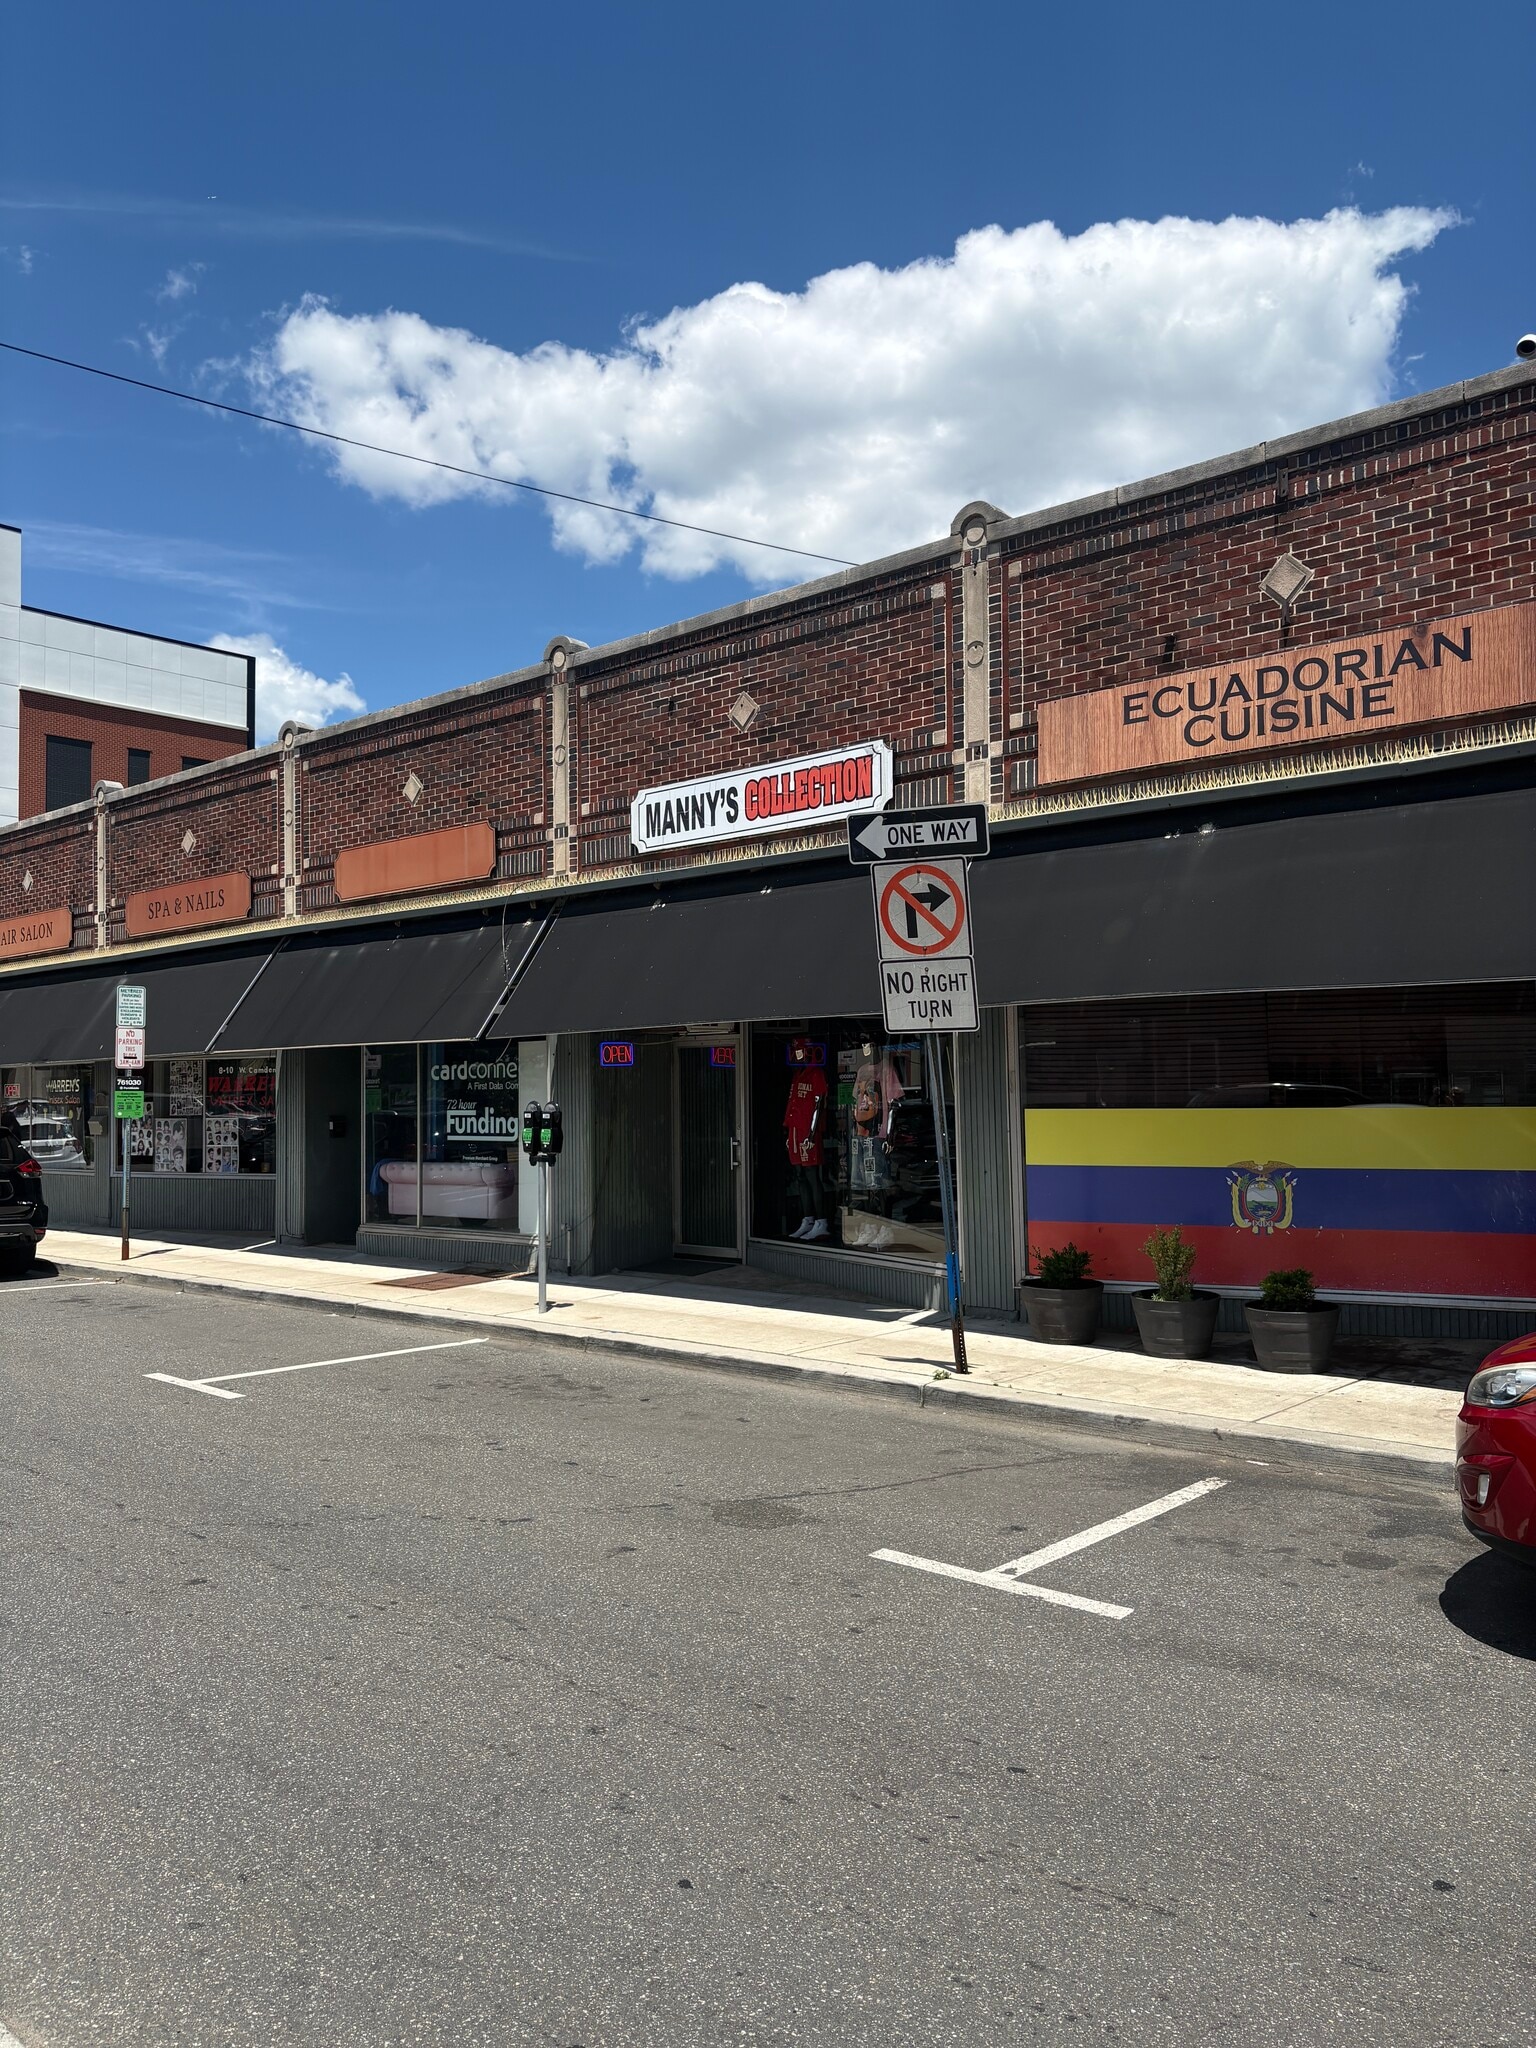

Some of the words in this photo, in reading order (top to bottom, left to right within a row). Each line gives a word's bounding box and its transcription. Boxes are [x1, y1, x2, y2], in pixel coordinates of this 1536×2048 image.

[1122, 626, 1473, 726] ECUADORIAN
[1183, 679, 1395, 748] CUISINE
[645, 785, 739, 839] MANNY'S
[744, 754, 873, 821] COLLECTION
[887, 824, 925, 847] ONE
[931, 820, 972, 842] WAY
[148, 902, 170, 920] SPA
[174, 898, 182, 915] &
[186, 889, 225, 912] NAILS
[0, 929, 17, 946] AIR
[20, 922, 53, 942] SALON
[886, 970, 914, 995] NO
[920, 971, 968, 994] RIGHT
[907, 998, 953, 1019] TURN
[126, 1030, 135, 1038] NO
[602, 1045, 632, 1063] OPEN
[248, 1066, 276, 1074] Camden
[474, 1082, 488, 1090] First
[488, 1082, 504, 1090] Data
[447, 1099, 458, 1110] 72
[458, 1099, 477, 1110] hour
[446, 1106, 519, 1142] Funding
